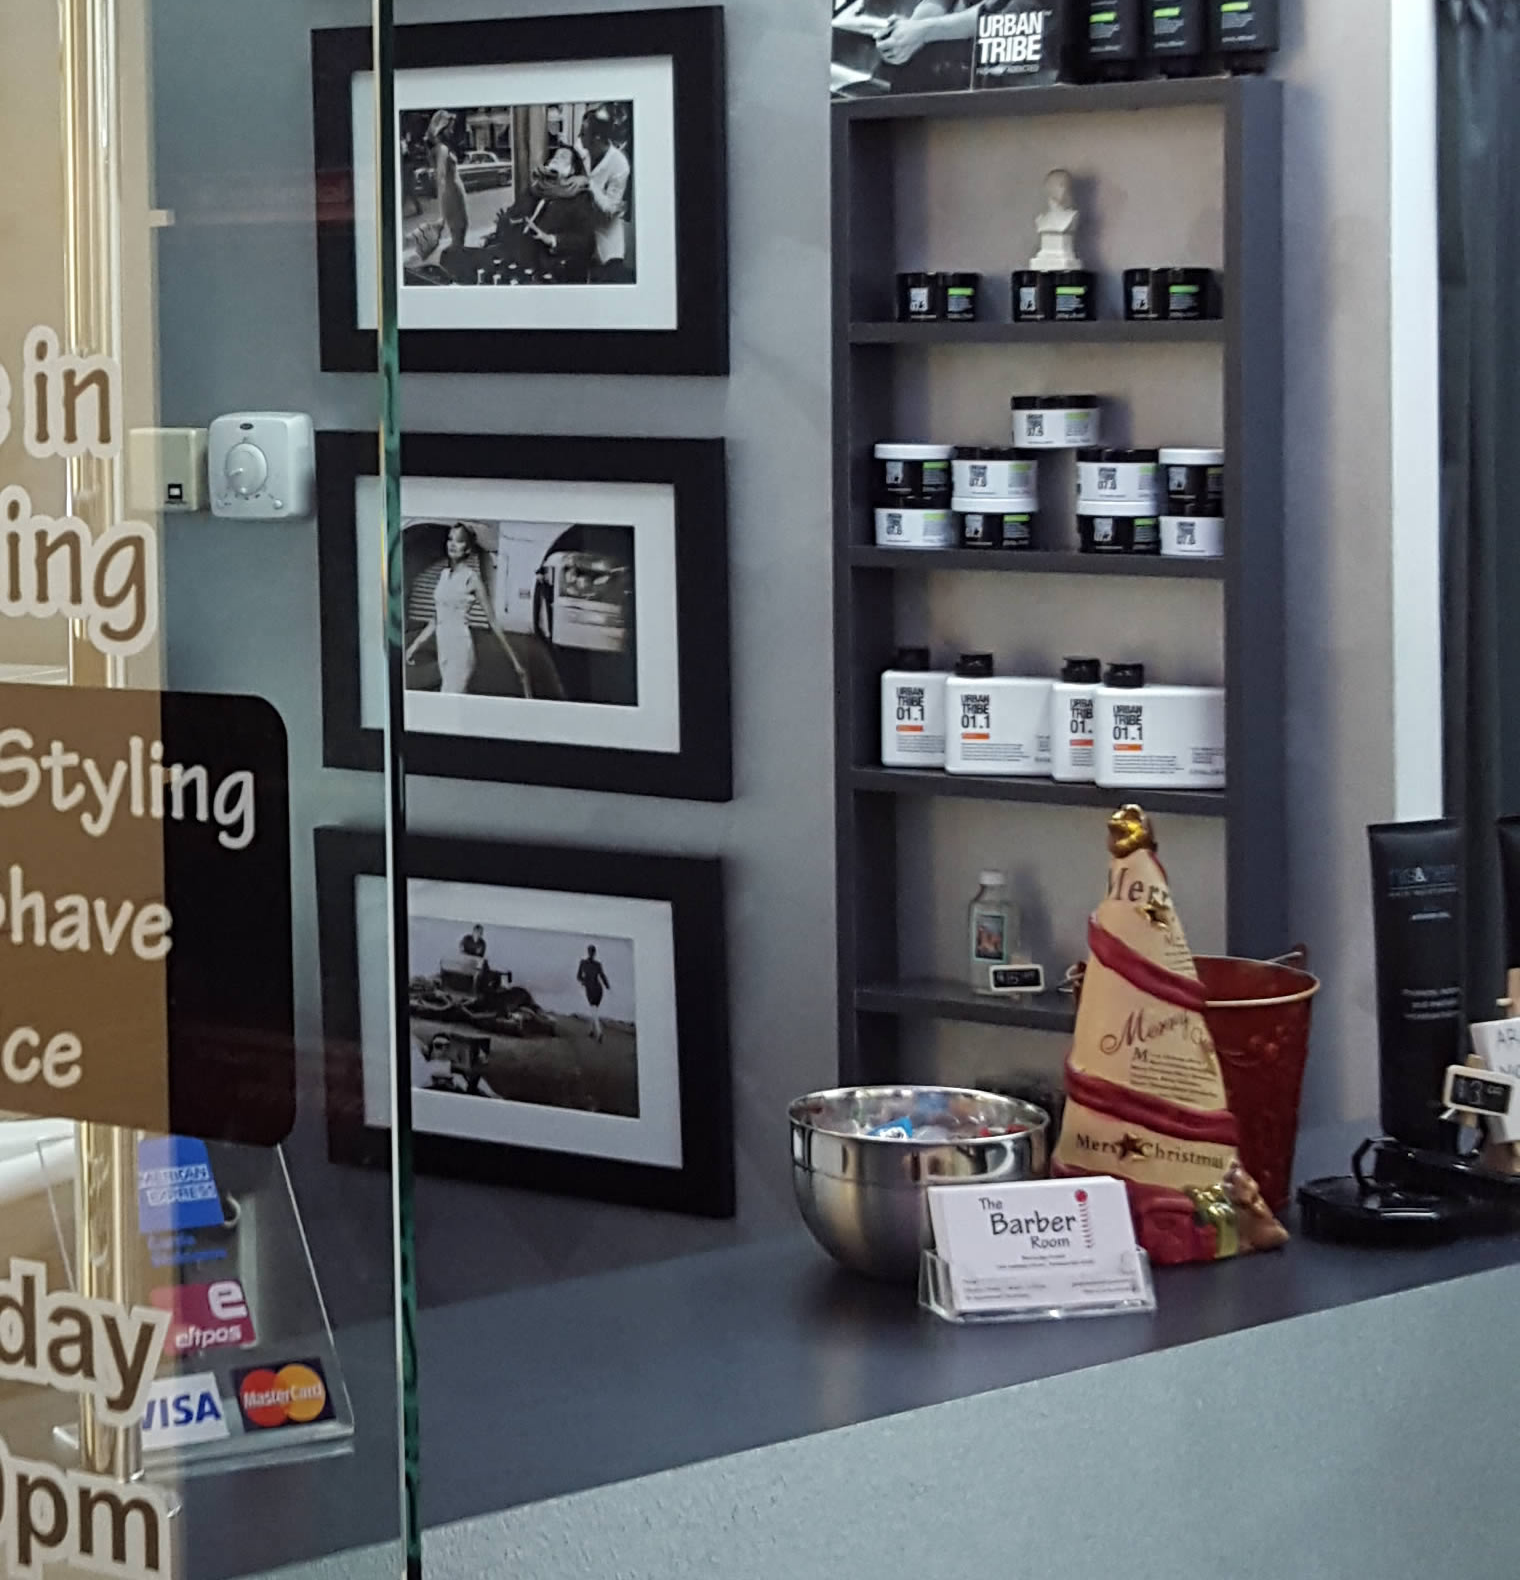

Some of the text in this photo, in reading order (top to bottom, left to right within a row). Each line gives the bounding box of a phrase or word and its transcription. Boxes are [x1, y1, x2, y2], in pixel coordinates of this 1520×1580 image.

[979, 10, 1043, 38] URBAN
[978, 34, 1042, 64] TRIBE
[34, 339, 113, 444] in
[7, 499, 146, 643] ing
[896, 707, 925, 721] 01.1
[1070, 698, 1094, 709] URBA
[1071, 708, 1094, 719] TRIB
[961, 714, 990, 729] 01.1
[1070, 719, 1093, 734] 01.
[1113, 726, 1143, 740] 01.1
[0, 728, 256, 850] Styling
[0, 864, 174, 960] have
[2, 1026, 83, 1088] ce
[979, 1196, 1003, 1211] The
[989, 1210, 1077, 1235] Barber
[1030, 1235, 1071, 1250] Room
[175, 1324, 243, 1350] eftpos
[243, 1382, 324, 1410] MasterCard
